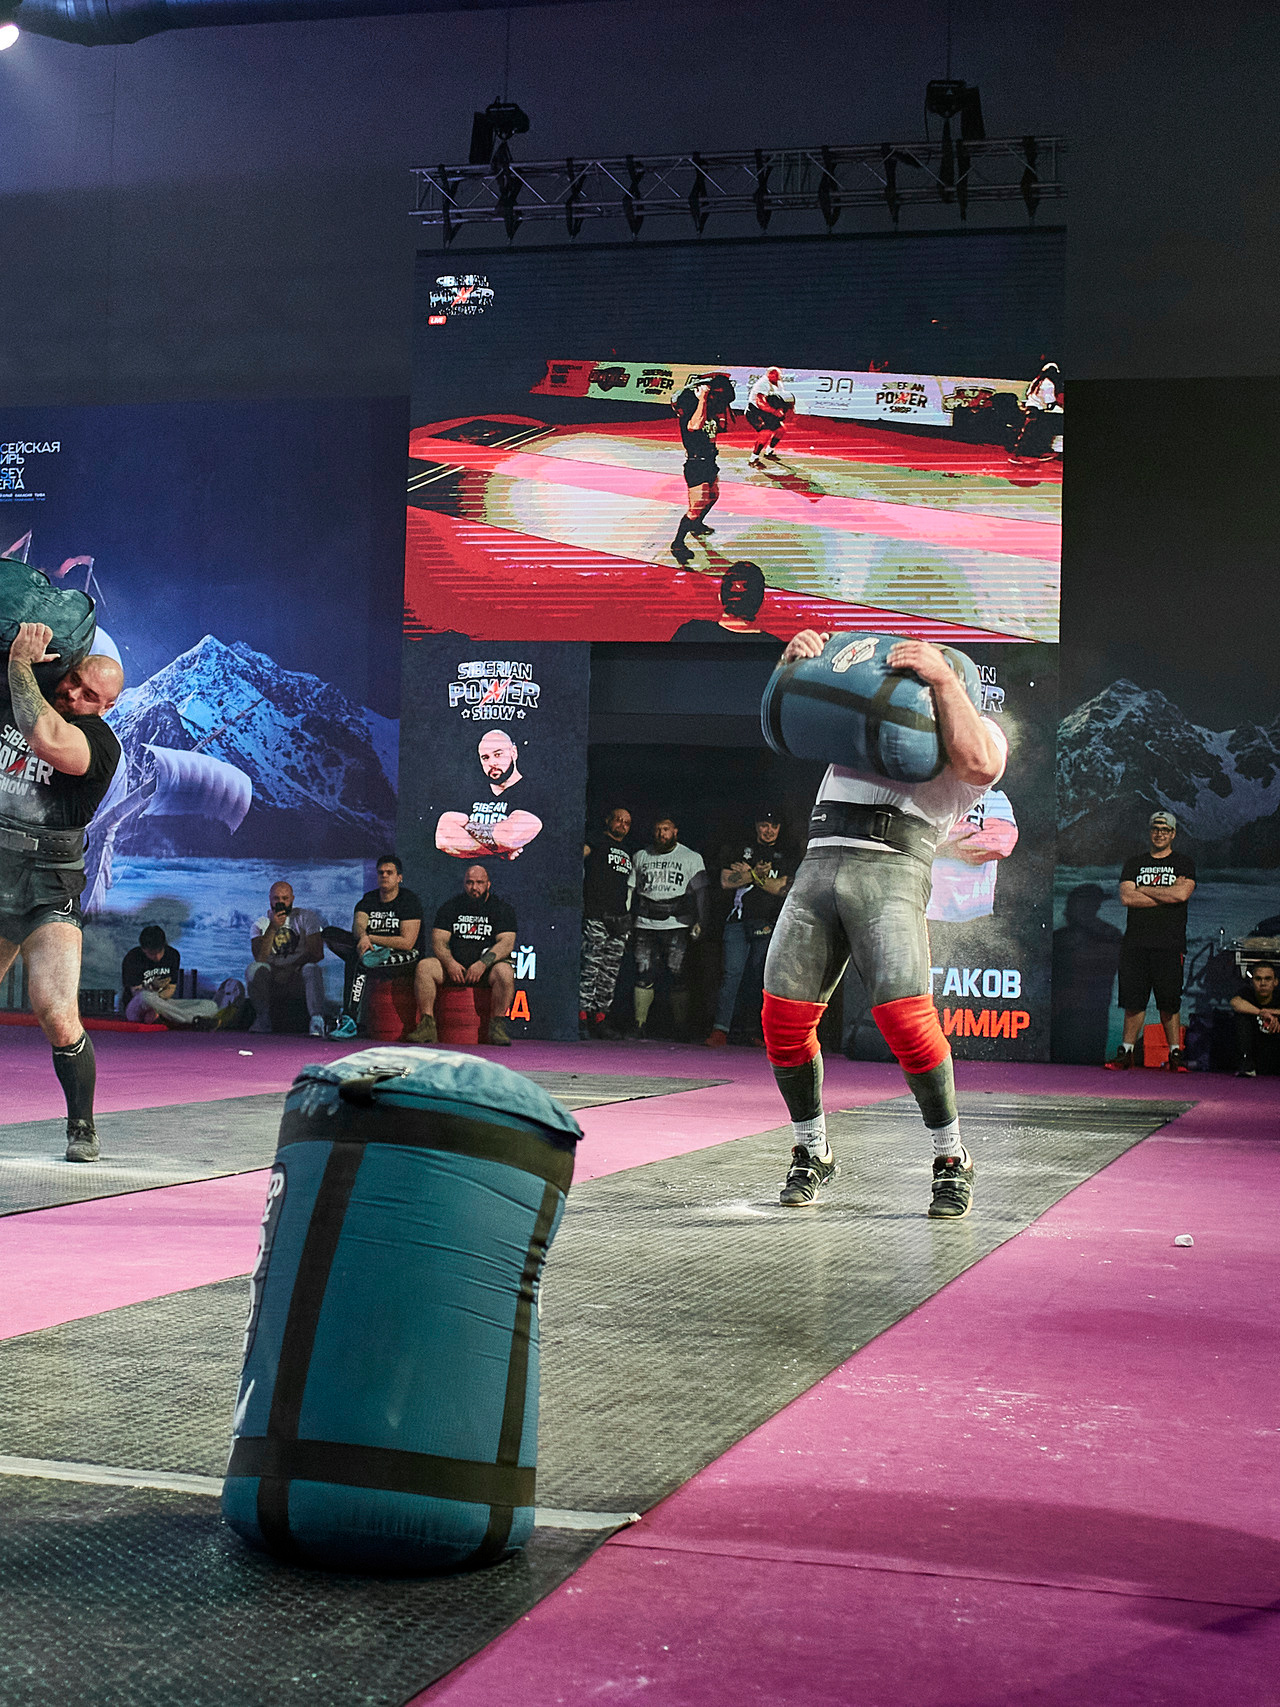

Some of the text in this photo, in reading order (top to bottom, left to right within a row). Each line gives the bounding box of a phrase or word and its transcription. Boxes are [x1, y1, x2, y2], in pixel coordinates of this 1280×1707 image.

[876, 392, 928, 408] POWER
[457, 661, 532, 680] SIBERIAN
[448, 679, 540, 708] POWER
[472, 705, 515, 720] SHOW
[642, 861, 682, 871] SIBERIAN
[1136, 873, 1177, 887] POWER
[453, 923, 493, 936] POWER
[352, 974, 367, 1002] Kappa
